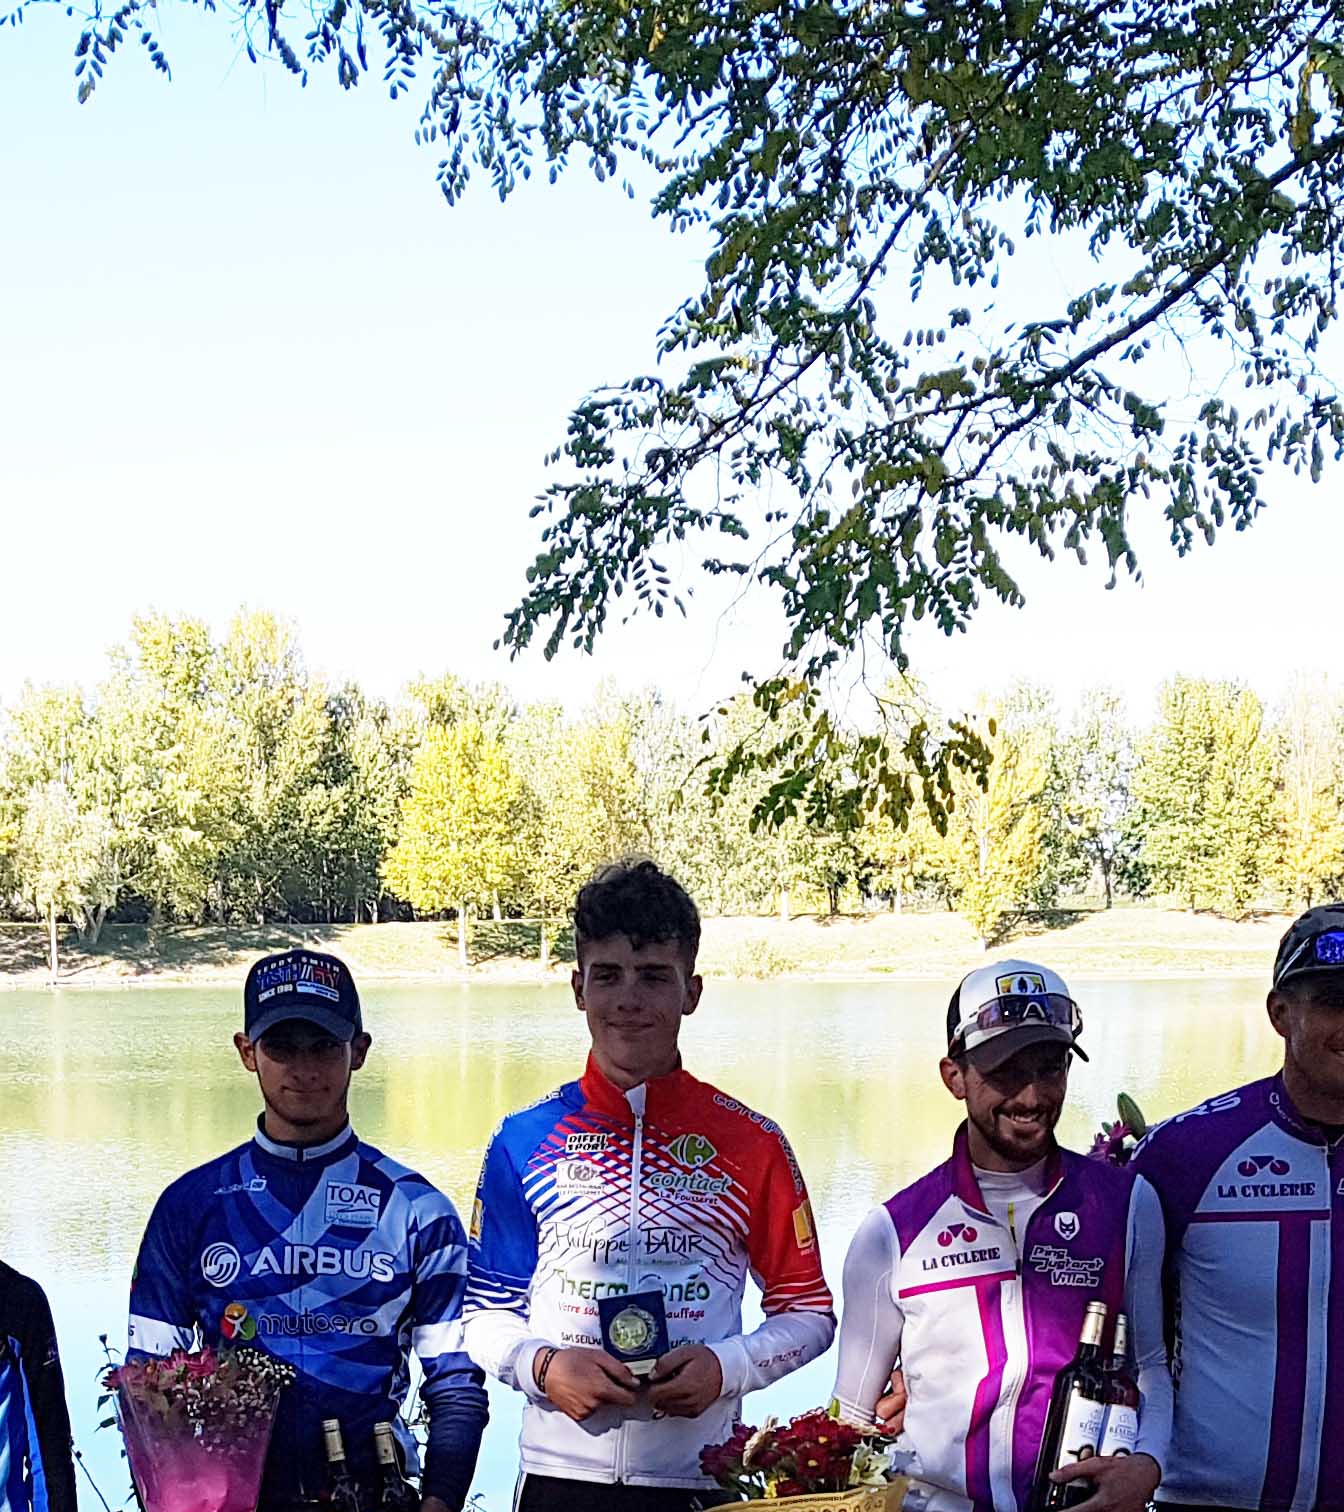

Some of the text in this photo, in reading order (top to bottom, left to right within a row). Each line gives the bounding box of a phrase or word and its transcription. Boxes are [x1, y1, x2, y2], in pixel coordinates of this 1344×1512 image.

[650, 1172, 732, 1193] contact
[1217, 1182, 1316, 1198] LA CYCLERIE
[327, 1185, 381, 1208] TOAC
[249, 1245, 395, 1283] AIRBUS
[922, 1247, 1001, 1272] LA CYCLERIE
[256, 1307, 378, 1335] mutaero
